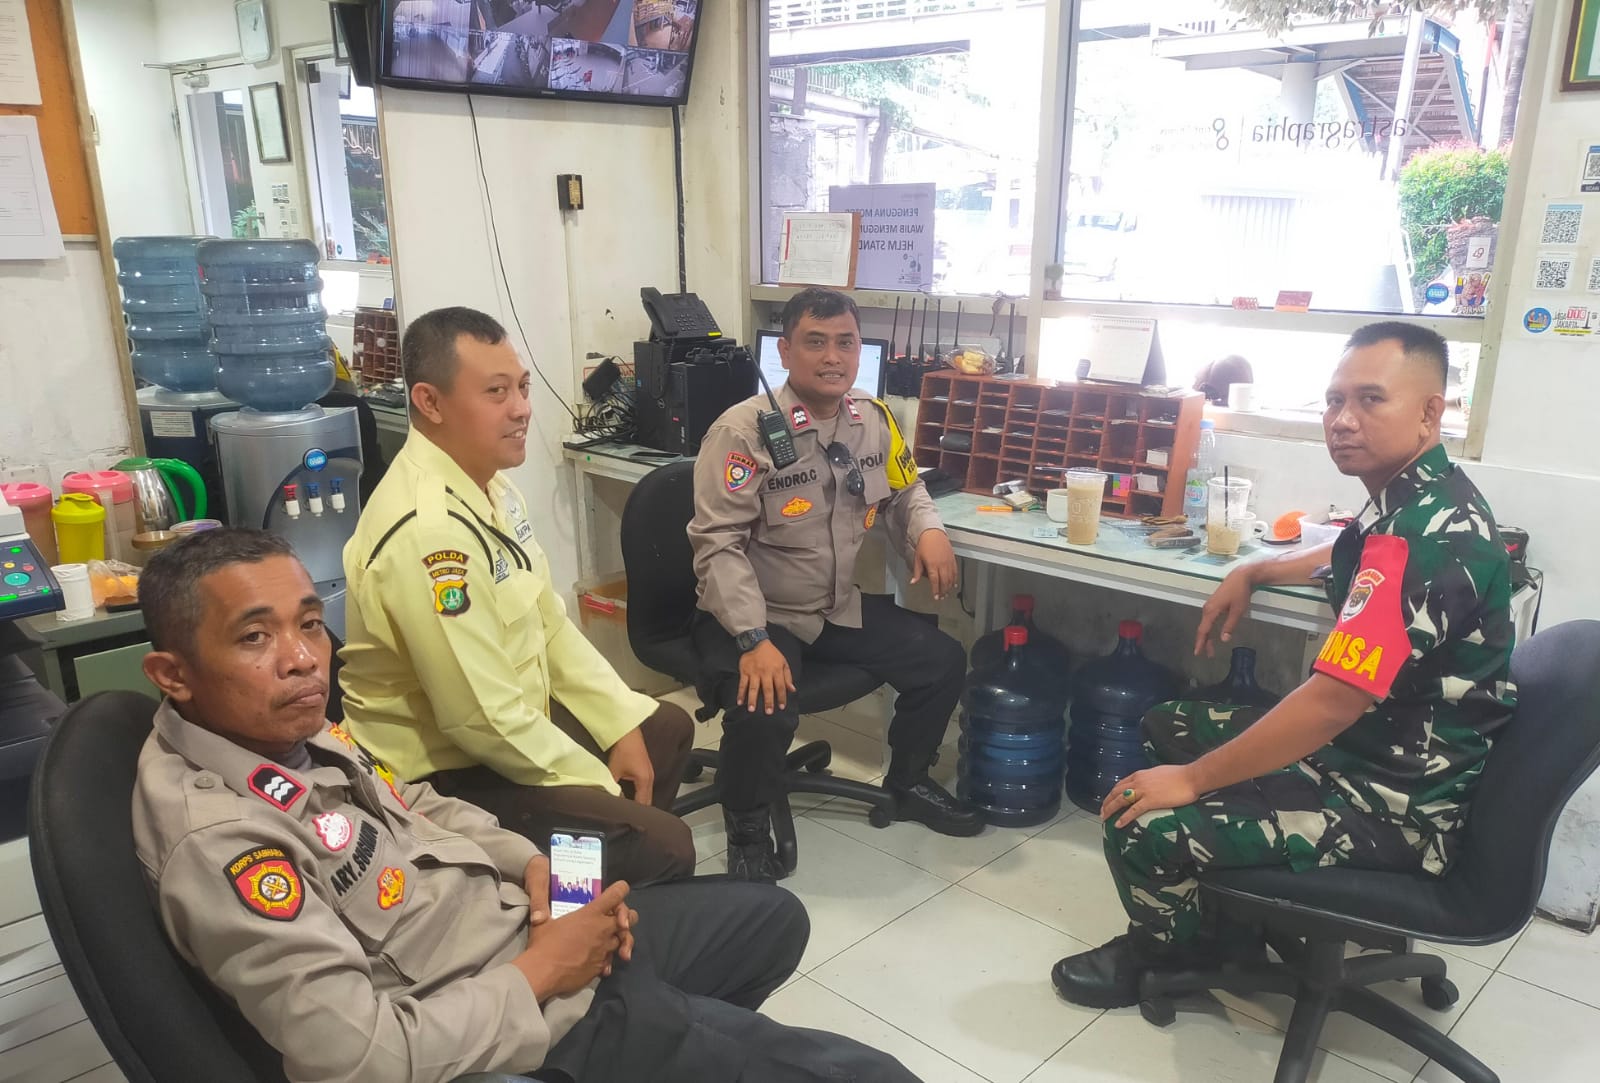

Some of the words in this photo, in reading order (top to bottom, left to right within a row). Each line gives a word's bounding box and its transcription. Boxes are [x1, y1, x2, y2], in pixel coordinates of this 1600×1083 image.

[767, 469, 817, 490] ENDRO.C
[427, 552, 464, 565] POLDA
[229, 854, 254, 876] KORPS
